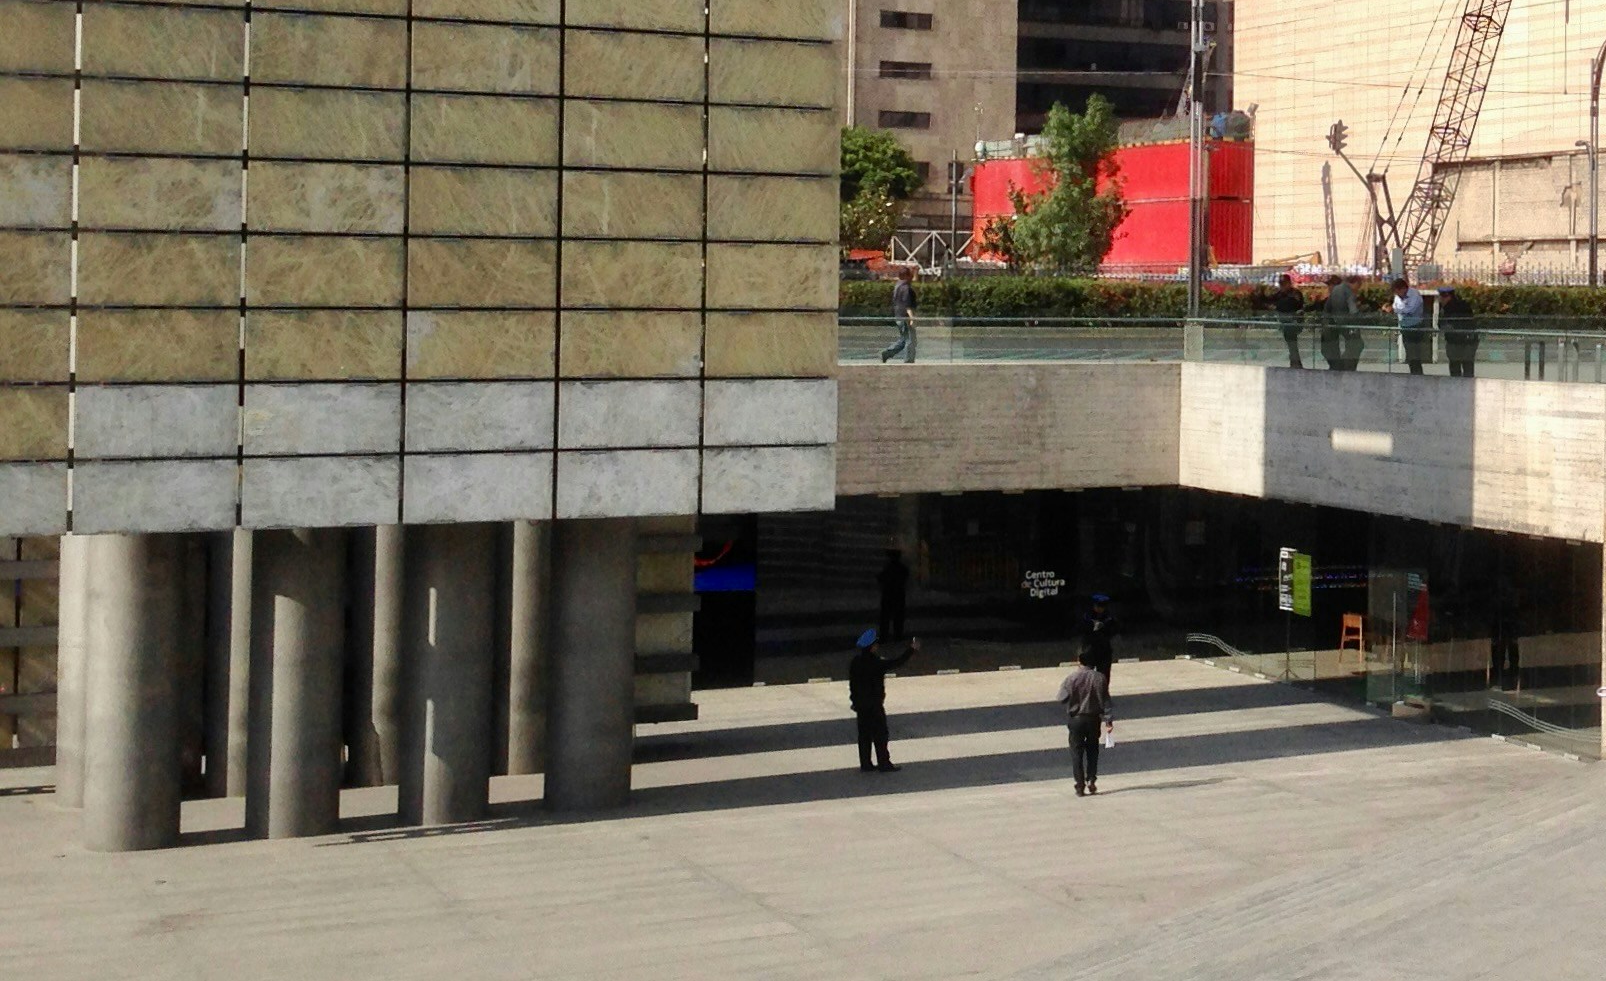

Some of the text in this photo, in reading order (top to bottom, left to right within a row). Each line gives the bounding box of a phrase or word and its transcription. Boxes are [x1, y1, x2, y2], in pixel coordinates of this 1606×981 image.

[1025, 570, 1055, 580] Centro
[1033, 578, 1066, 588] Cultura
[1030, 586, 1059, 599] Digital
